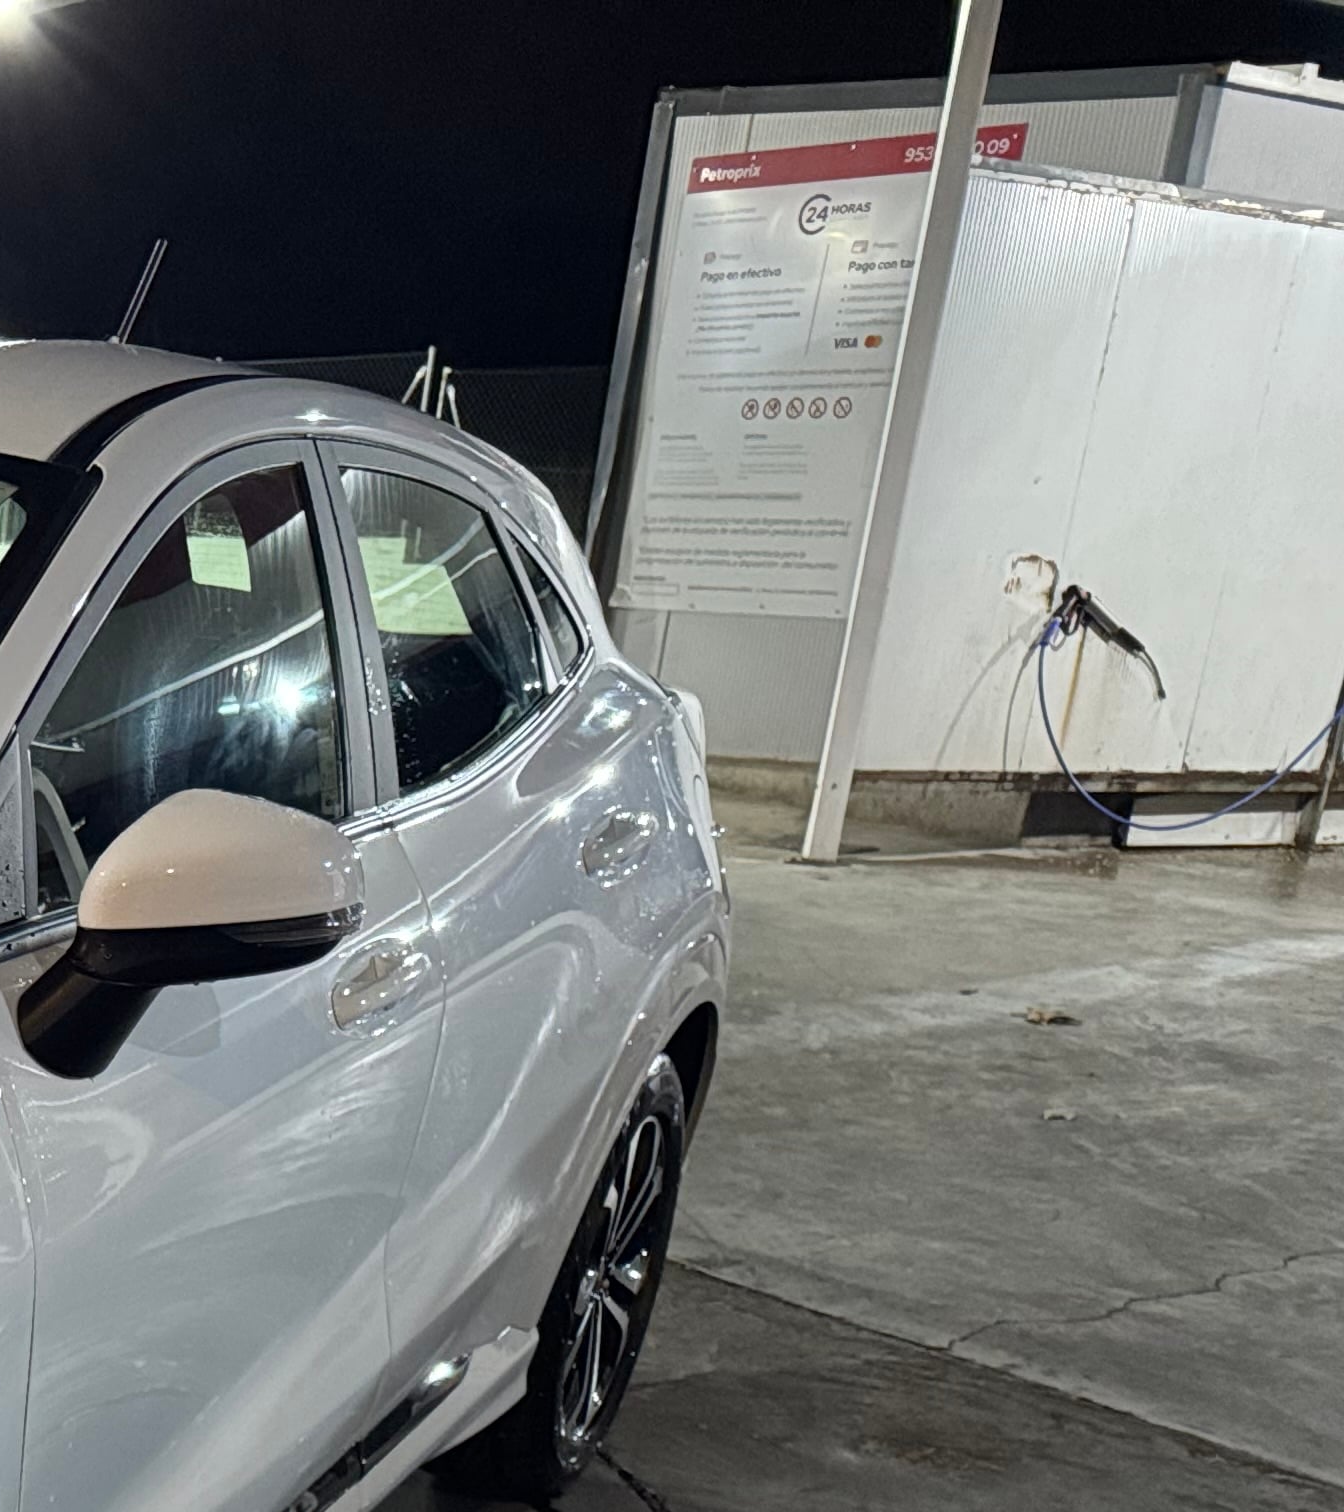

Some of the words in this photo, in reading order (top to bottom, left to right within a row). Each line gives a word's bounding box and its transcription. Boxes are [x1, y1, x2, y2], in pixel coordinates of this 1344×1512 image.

[904, 145, 935, 163] 953
[987, 138, 1010, 155] 09
[700, 163, 762, 184] Petroprix
[805, 204, 829, 223] 24
[831, 202, 872, 215] HORAS
[700, 271, 725, 284] Pago
[740, 267, 782, 280] efectivo
[848, 261, 876, 274] Pago
[877, 261, 898, 271] con
[834, 338, 858, 349] VISA
